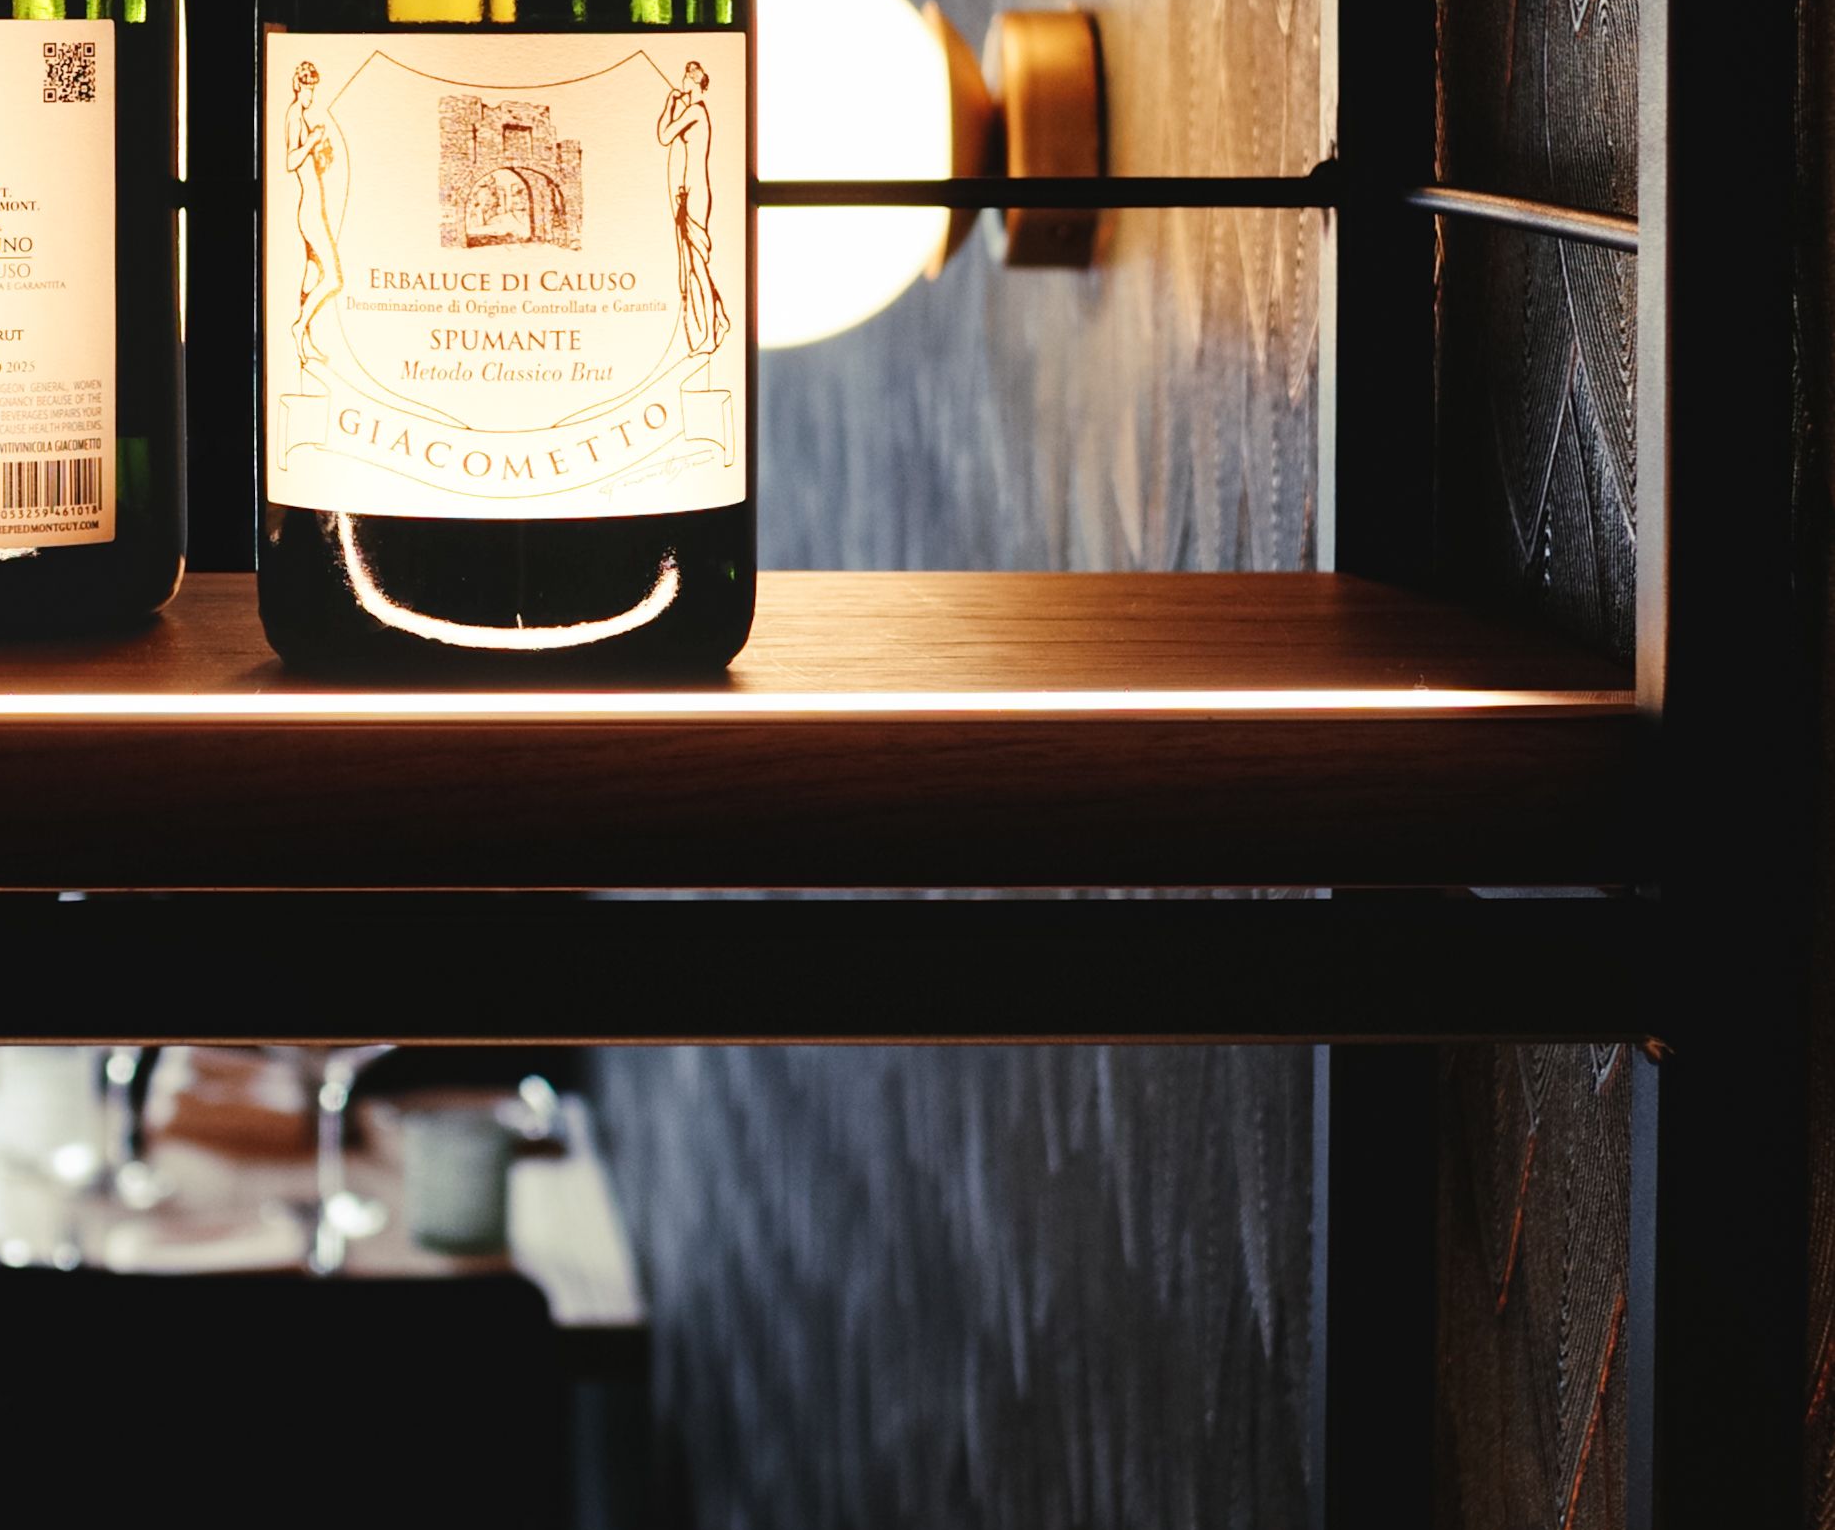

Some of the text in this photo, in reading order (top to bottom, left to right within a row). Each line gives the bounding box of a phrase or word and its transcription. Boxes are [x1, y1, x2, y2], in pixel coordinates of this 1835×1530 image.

[369, 268, 637, 292] ERBALUCE DI CALUSO
[346, 297, 667, 317] Denominazione di Origine Controllata e Garantita
[430, 329, 582, 351] SPUMANTE
[6, 361, 36, 373] 2025
[400, 362, 613, 382] Metodo Classico Brut
[73, 379, 102, 390] WOMEN
[37, 394, 72, 405] BECAUSE
[75, 394, 84, 404] OF
[88, 392, 101, 403] THE
[1, 410, 48, 420] BEVERAGES
[83, 406, 102, 417] YOUR
[0, 424, 25, 434] CAUSE
[55, 437, 102, 451] GIACOMETTO
[338, 403, 667, 481] GIACOMETTO
